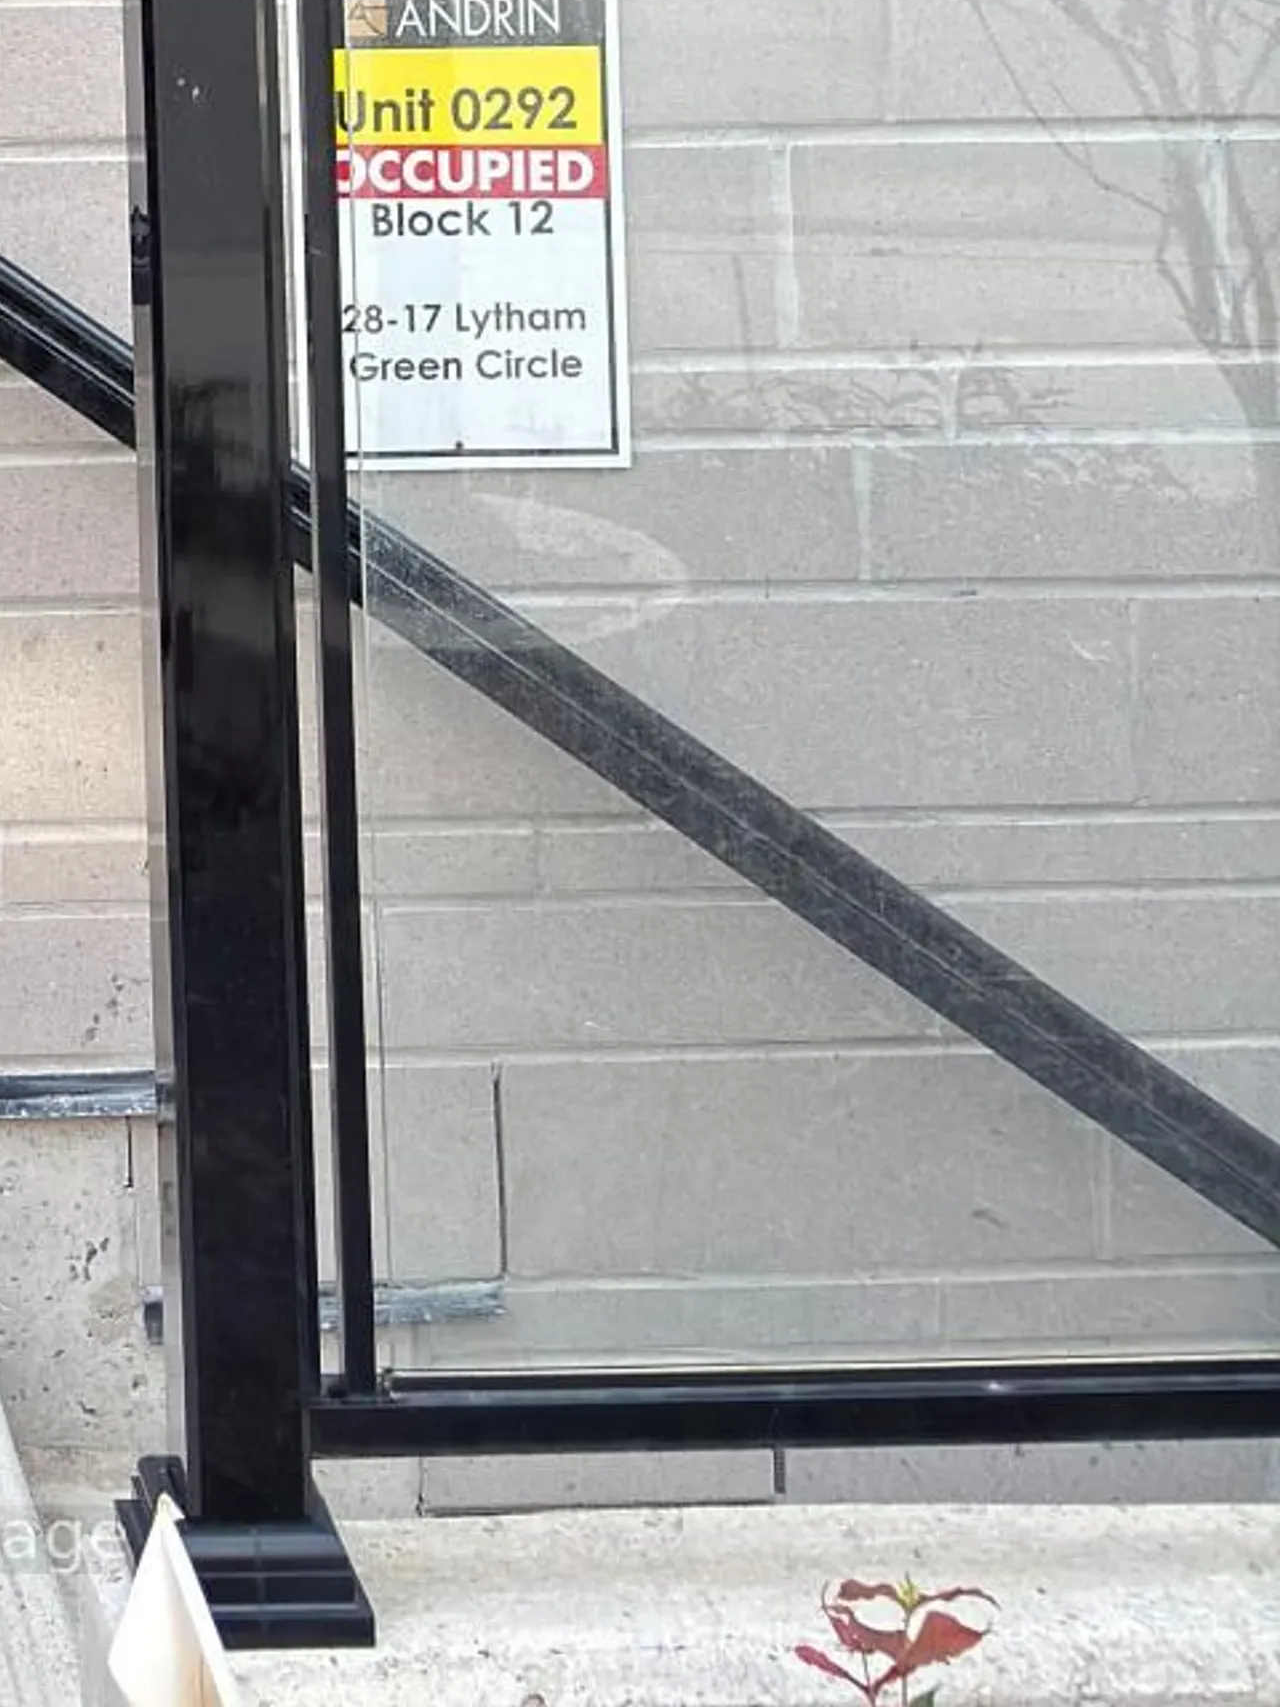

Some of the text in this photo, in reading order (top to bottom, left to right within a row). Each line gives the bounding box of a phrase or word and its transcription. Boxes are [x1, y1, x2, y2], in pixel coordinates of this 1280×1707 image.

[334, 86, 578, 132] Unit 0292
[336, 149, 594, 193] OCCUPIED
[372, 200, 554, 237] Block 12
[342, 302, 586, 340] 28-17 Lytham
[350, 348, 583, 382] Green Circle
